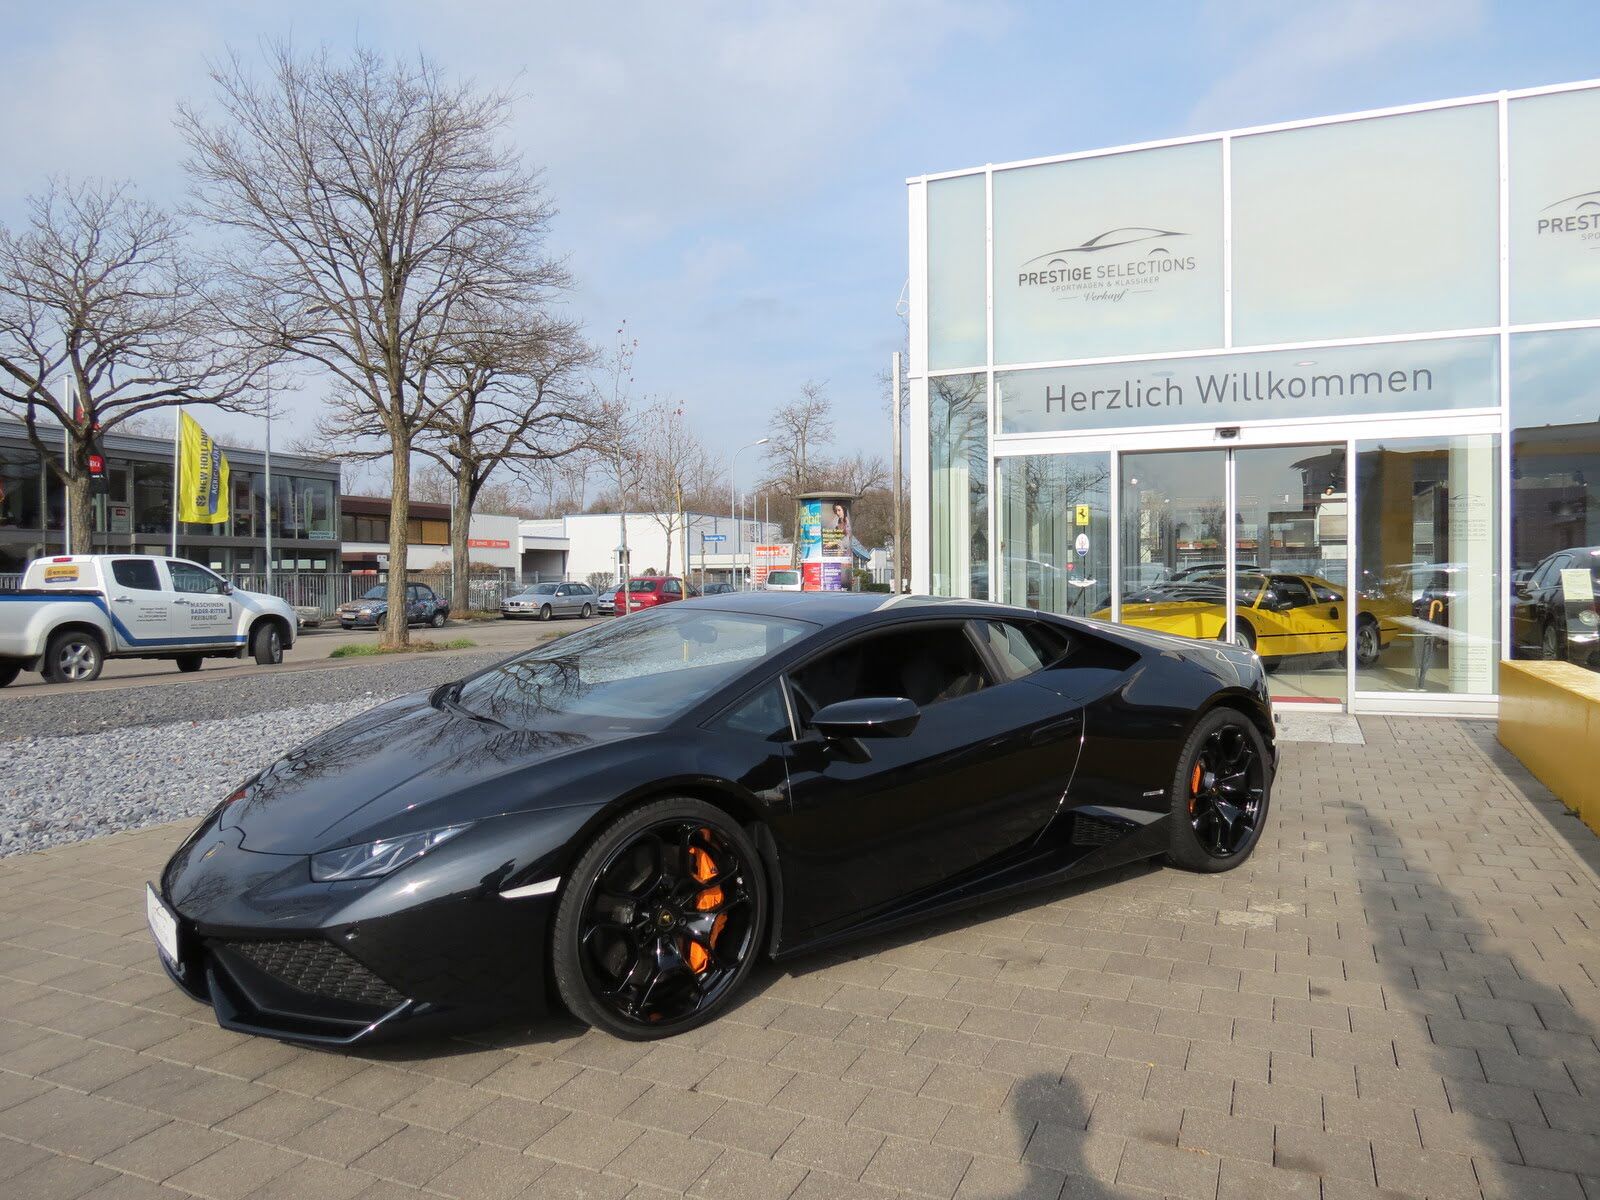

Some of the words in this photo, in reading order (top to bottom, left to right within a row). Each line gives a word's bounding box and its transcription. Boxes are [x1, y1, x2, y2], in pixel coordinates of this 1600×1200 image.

[1018, 267, 1093, 287] PRESTIGE
[1096, 256, 1196, 279] SELECTIONS
[1051, 281, 1104, 293] SPORTWAGEN
[1115, 276, 1160, 286] KLASSIKER
[1045, 378, 1183, 413] Herzlich
[1195, 368, 1433, 404] Willkommen
[199, 471, 208, 494] NEW
